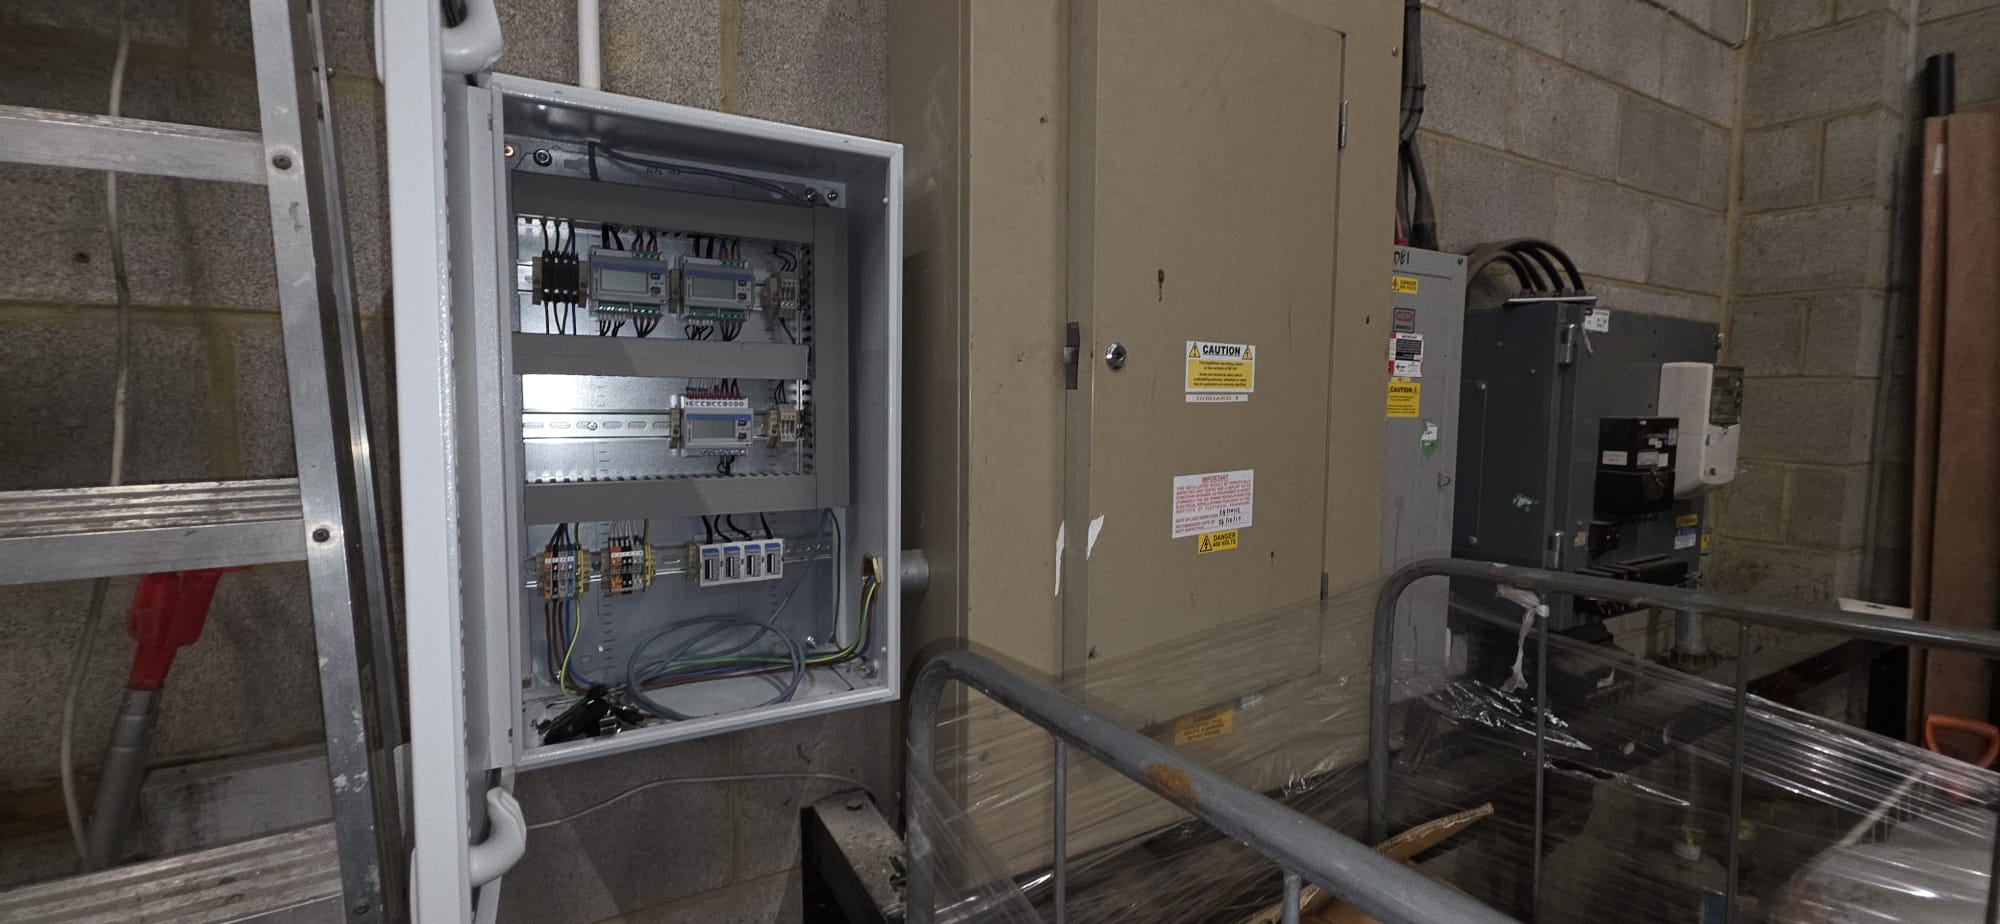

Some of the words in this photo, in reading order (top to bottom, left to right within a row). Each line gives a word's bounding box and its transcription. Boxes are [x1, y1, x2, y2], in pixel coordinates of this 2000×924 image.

[1203, 345, 1241, 356] CAUTION
[1213, 532, 1236, 541] DANGER
[1221, 538, 1236, 546] VOLTS
